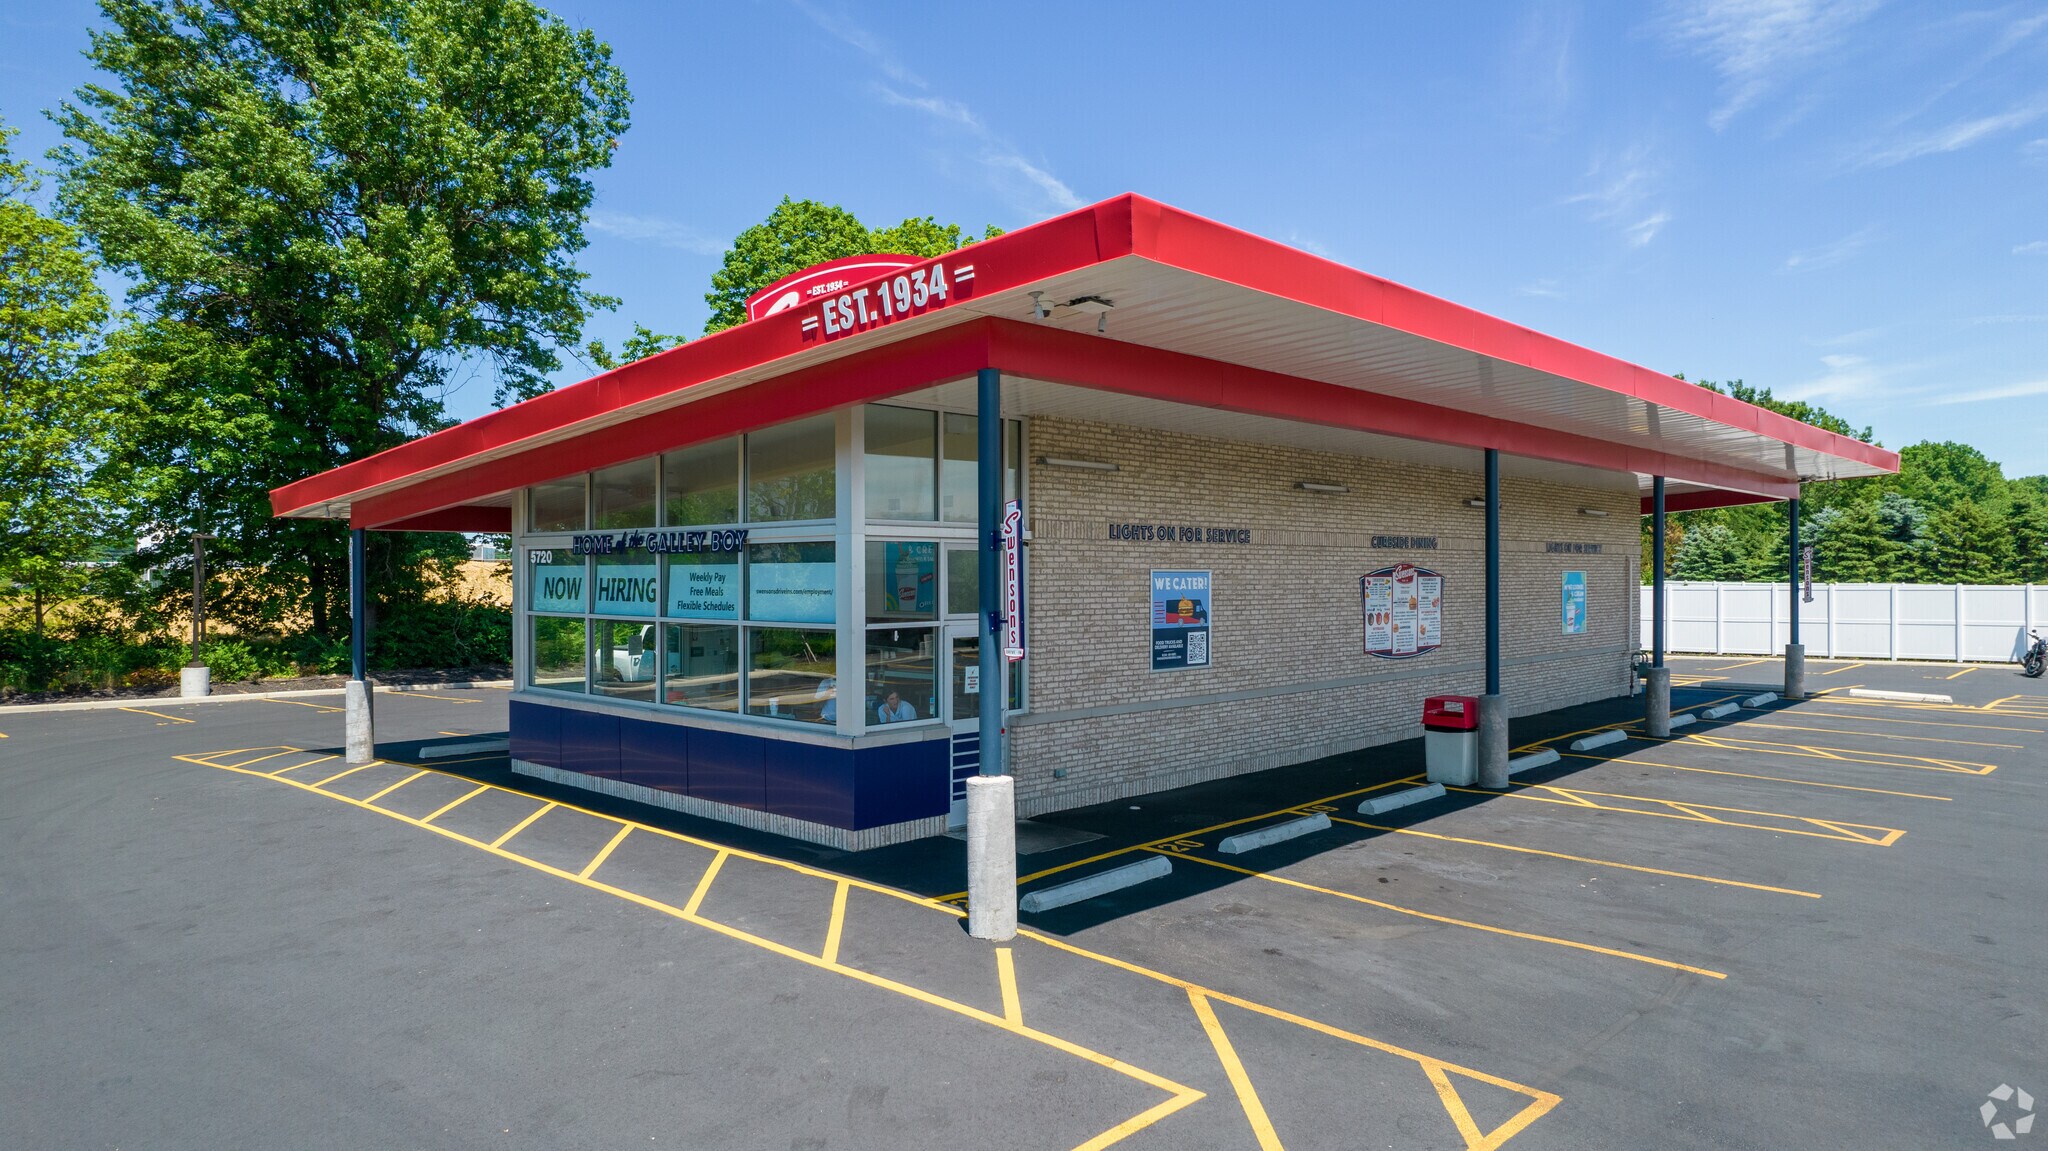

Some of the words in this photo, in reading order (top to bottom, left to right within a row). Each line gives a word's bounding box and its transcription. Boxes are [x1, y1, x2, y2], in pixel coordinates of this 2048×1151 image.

[1109, 524, 1154, 541] LIGHTS
[1157, 525, 1176, 541] ON
[1179, 526, 1203, 542] FOR
[1206, 528, 1250, 544] SERVICE
[572, 535, 614, 555] HOME
[629, 529, 646, 548] the
[646, 533, 707, 554] GALLEY
[711, 530, 749, 552] BOY
[1371, 536, 1409, 549] CURBSIDE
[1410, 536, 1438, 549] DINING
[530, 550, 553, 564] 5720
[689, 572, 714, 585] Weekly
[714, 573, 726, 585] Pay
[1004, 510, 1020, 644] Swensons
[1155, 577, 1171, 590] WE
[1172, 577, 1208, 590] CATER!
[543, 577, 582, 600] NOW
[598, 578, 656, 603] HIRING
[690, 587, 704, 597] Free
[705, 587, 724, 597] Meals
[677, 601, 702, 611] Flexible
[703, 601, 735, 612] Schedules
